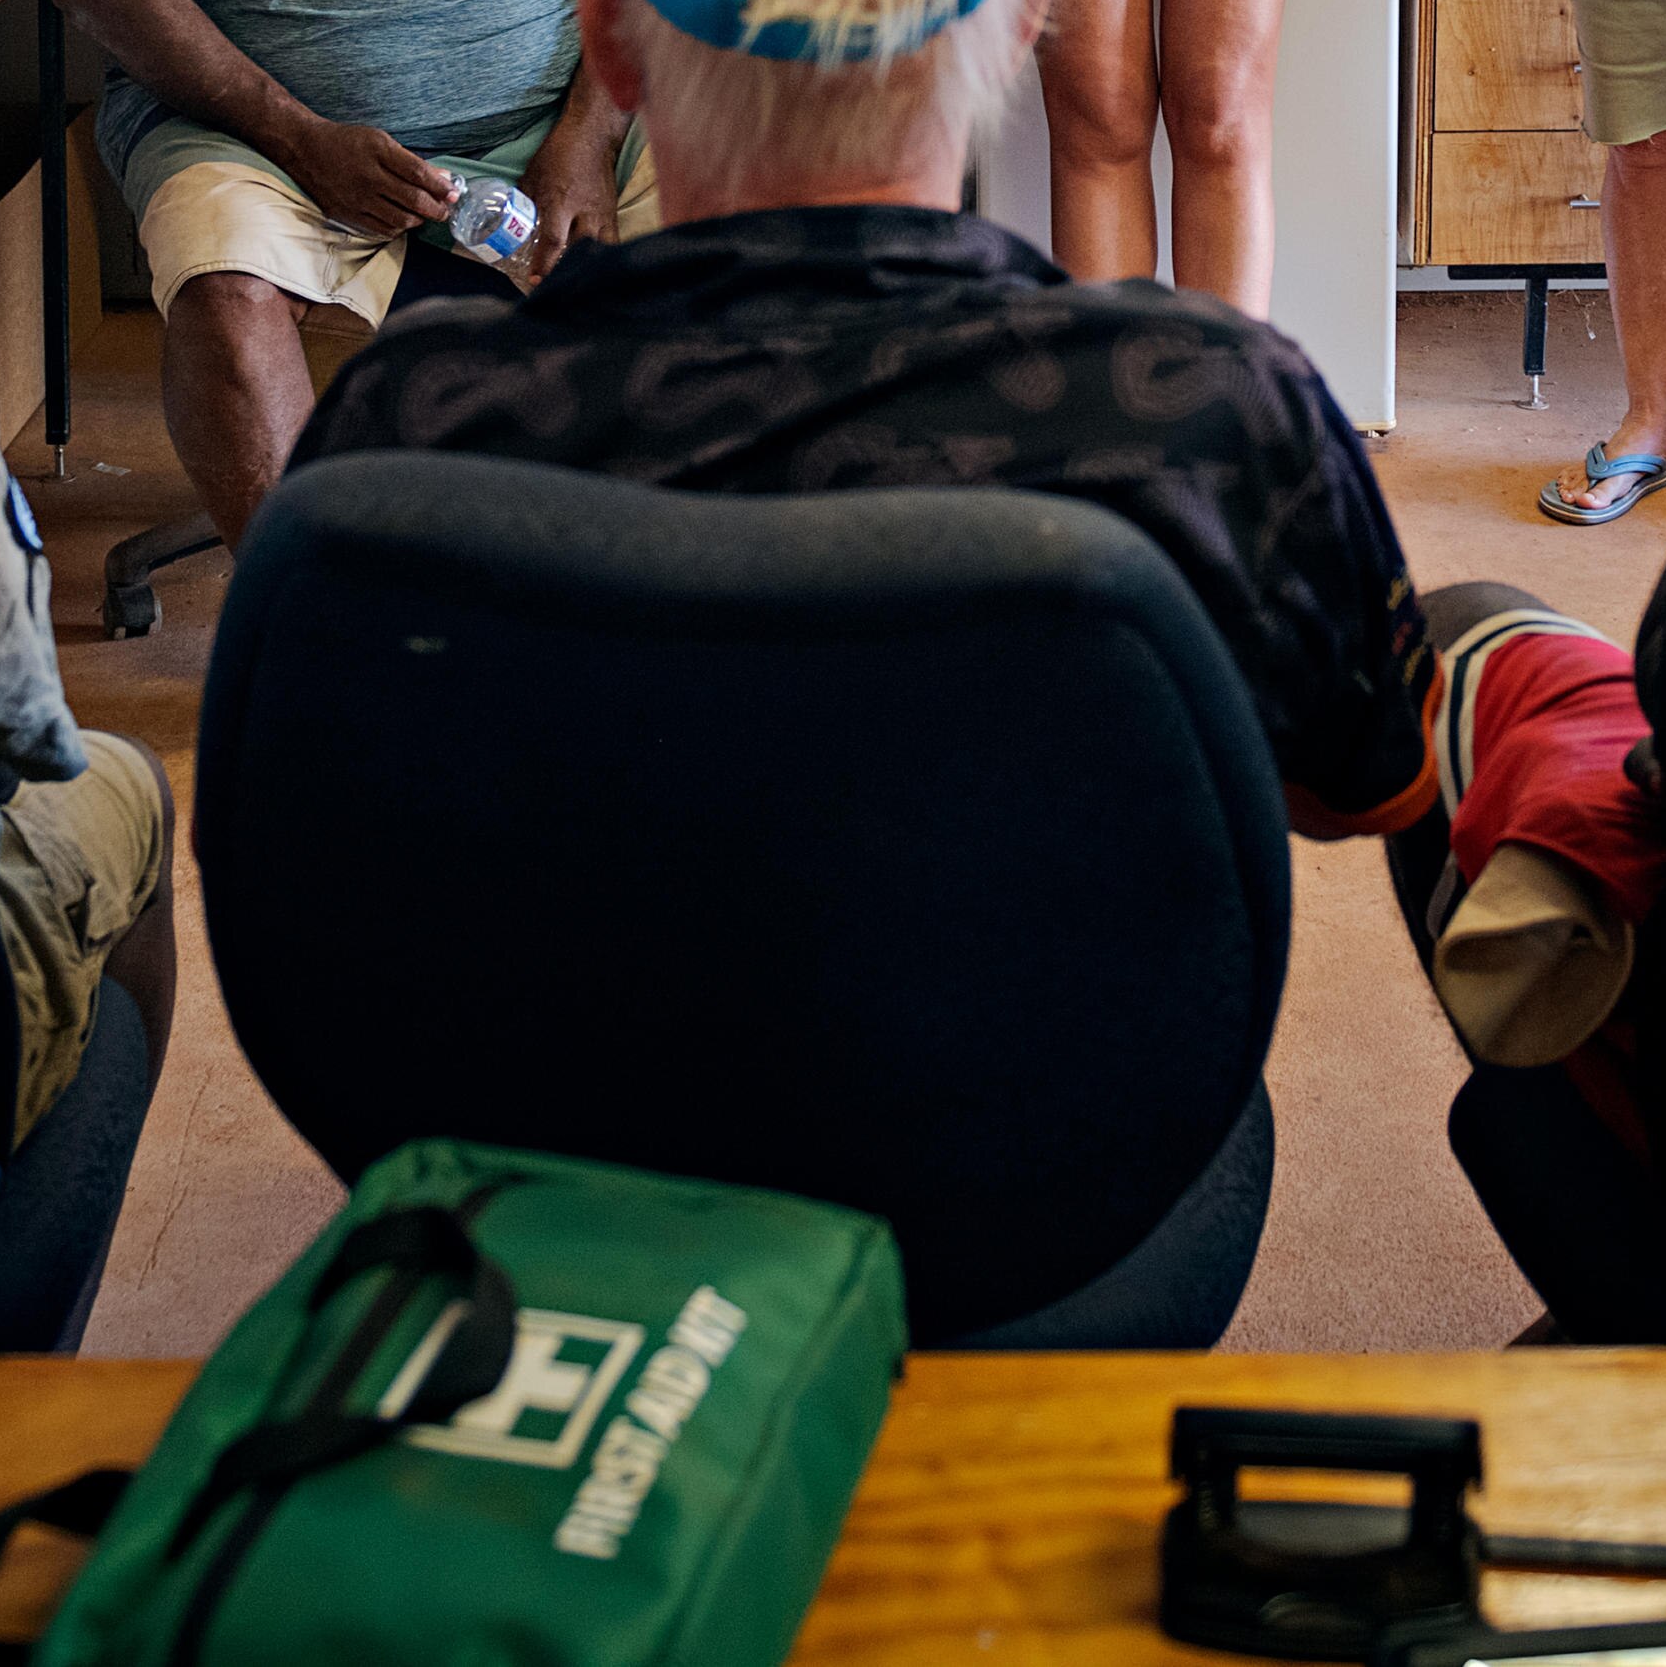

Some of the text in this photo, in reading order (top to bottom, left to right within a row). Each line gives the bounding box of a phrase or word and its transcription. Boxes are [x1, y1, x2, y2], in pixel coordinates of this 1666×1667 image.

[552, 1283, 749, 1561] FIRST AID KIT
